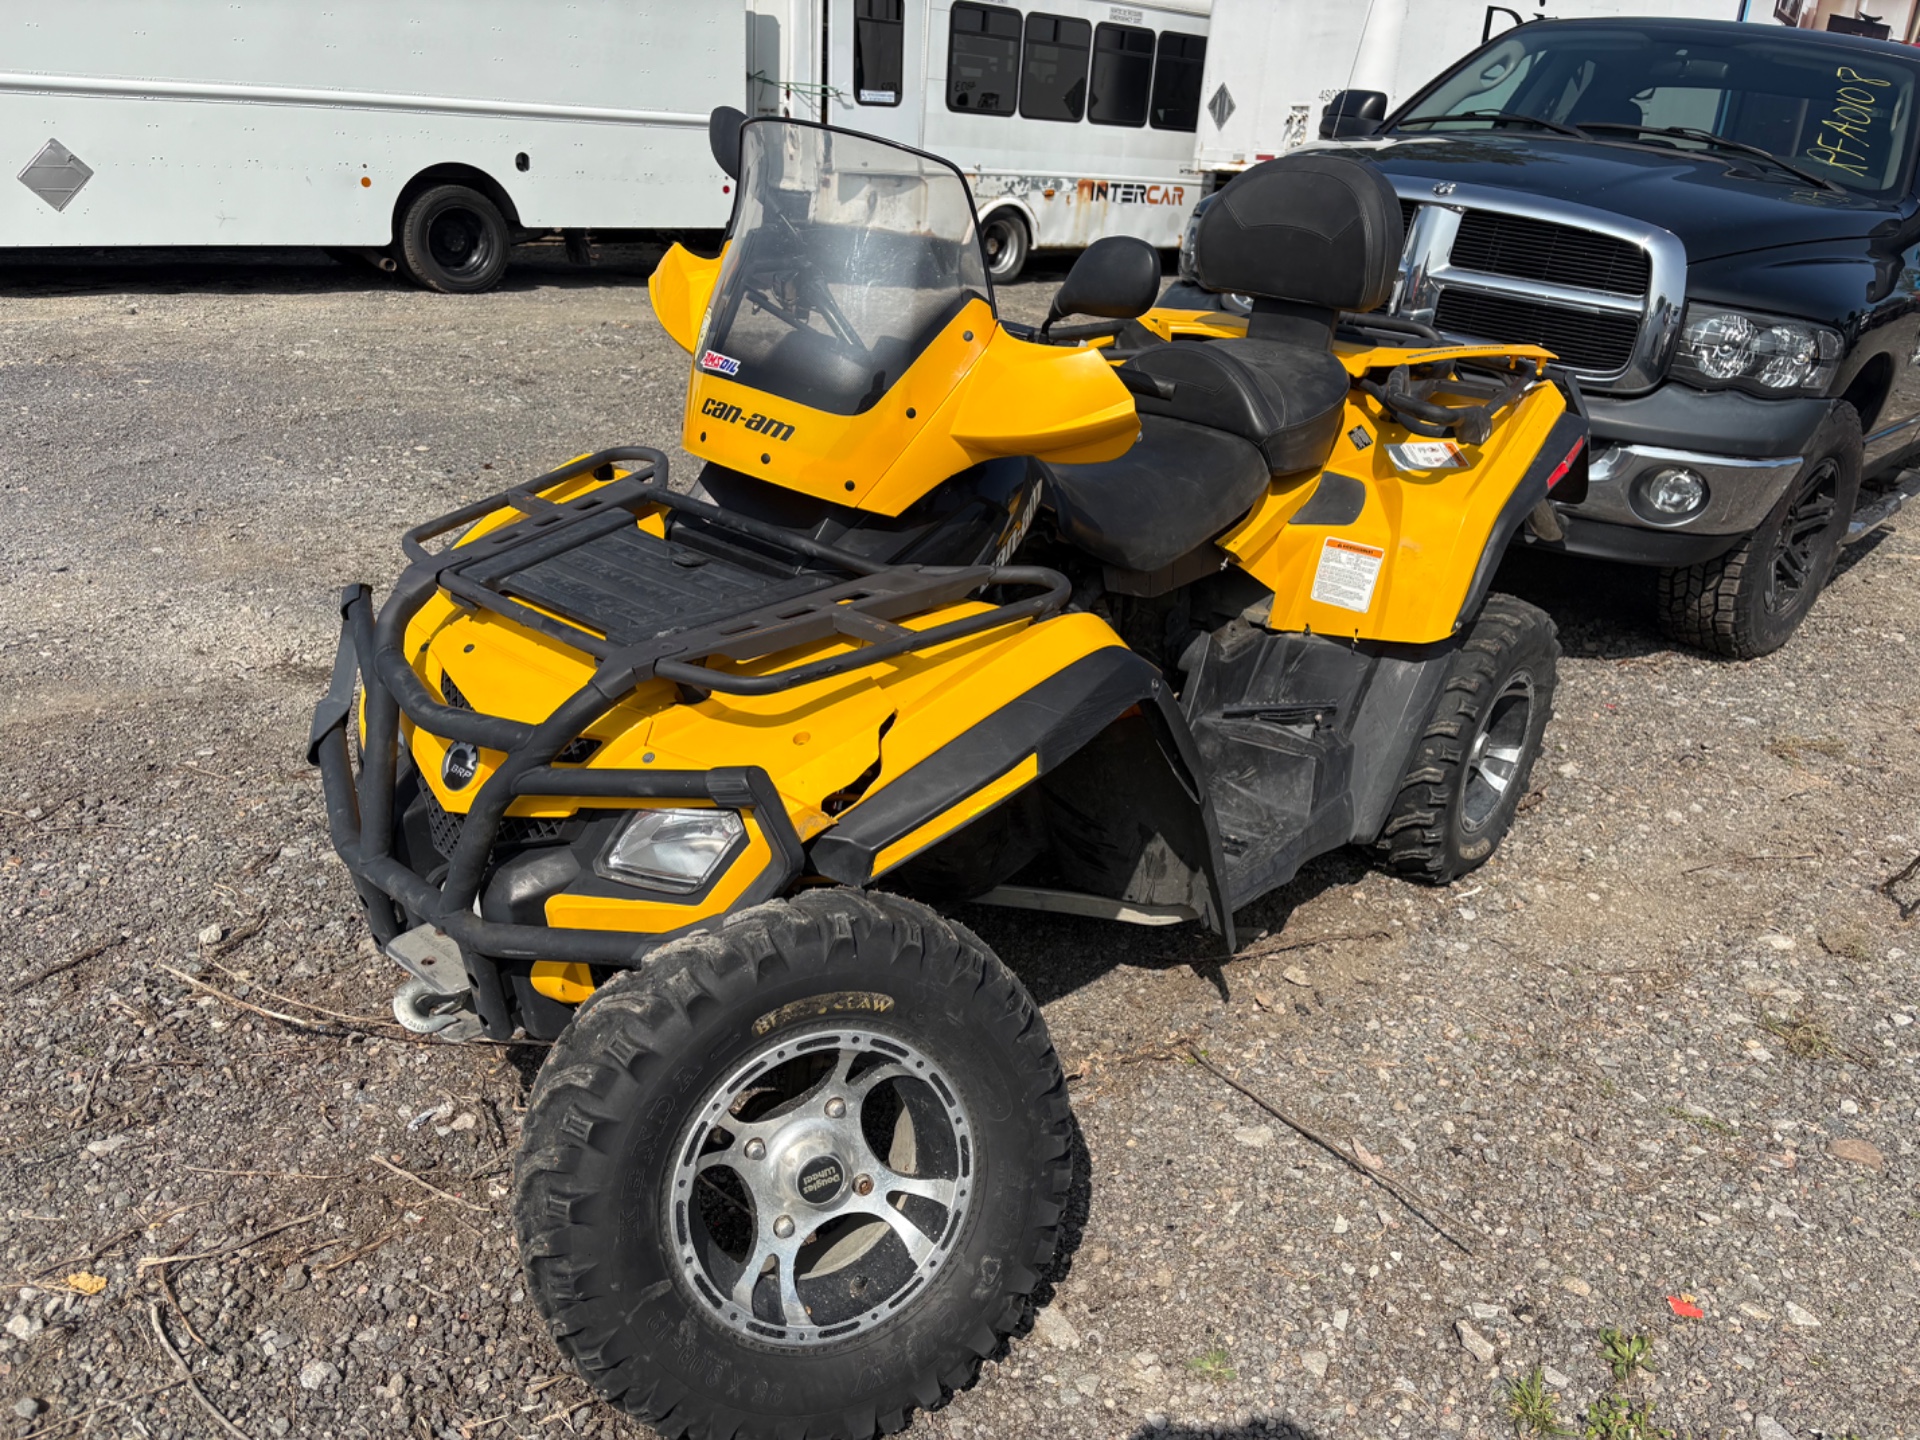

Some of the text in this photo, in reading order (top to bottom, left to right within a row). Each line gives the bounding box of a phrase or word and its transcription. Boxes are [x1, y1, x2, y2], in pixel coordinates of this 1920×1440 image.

[1089, 180, 1185, 206] INTERCAR
[702, 352, 738, 374] AMSOIL
[701, 397, 796, 442] can-am
[450, 763, 473, 779] BRP
[802, 1173, 841, 1195] Douglas
